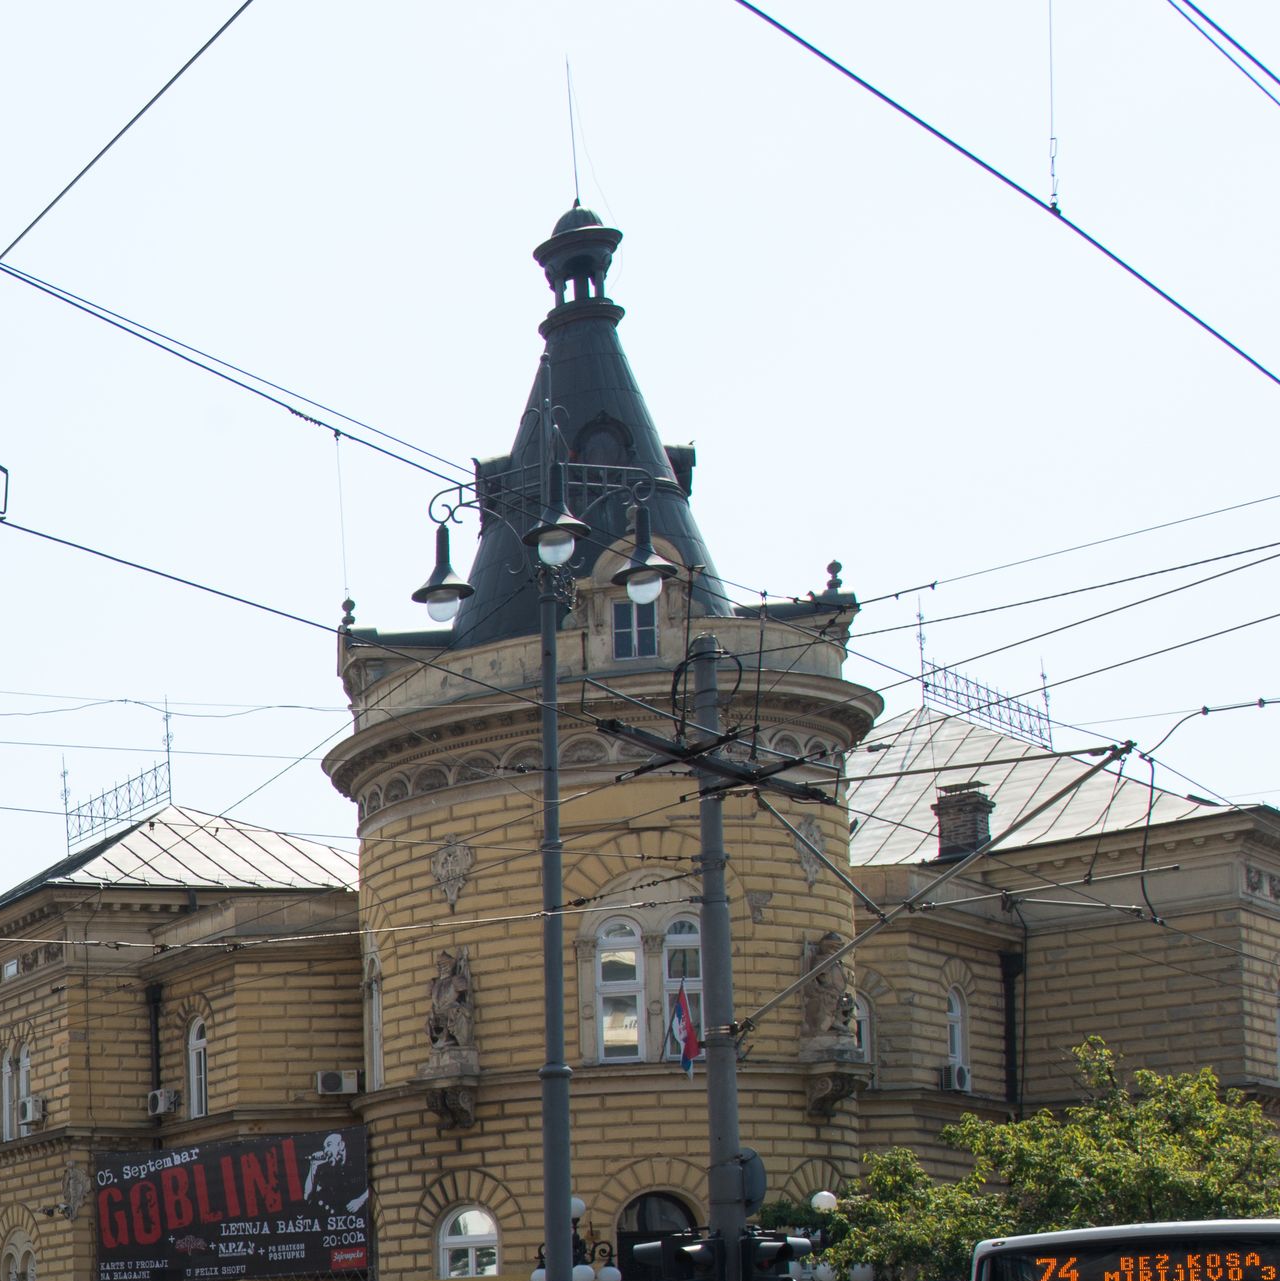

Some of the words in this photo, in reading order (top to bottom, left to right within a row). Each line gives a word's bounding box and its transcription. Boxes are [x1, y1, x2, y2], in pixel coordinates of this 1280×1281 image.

[97, 1168, 119, 1187] 05.
[123, 1146, 201, 1181] Septembar
[97, 1138, 305, 1249] GOBLINI
[220, 1219, 271, 1237] LETNJA
[276, 1215, 322, 1235] BAŠTA
[327, 1214, 366, 1231] SKCa
[322, 1231, 366, 1247] 20:00h
[268, 1250, 306, 1262] POSTUPKU
[99, 1261, 125, 1271] KARTE
[127, 1261, 133, 1269] U
[135, 1259, 169, 1269] PRODAJI
[186, 1268, 192, 1277] U
[194, 1267, 219, 1276] FELIX
[221, 1265, 246, 1275] SHOPU
[1260, 1265, 1278, 1281] 3
[100, 1271, 111, 1281] NA
[113, 1270, 150, 1280] BLAGAJNI
